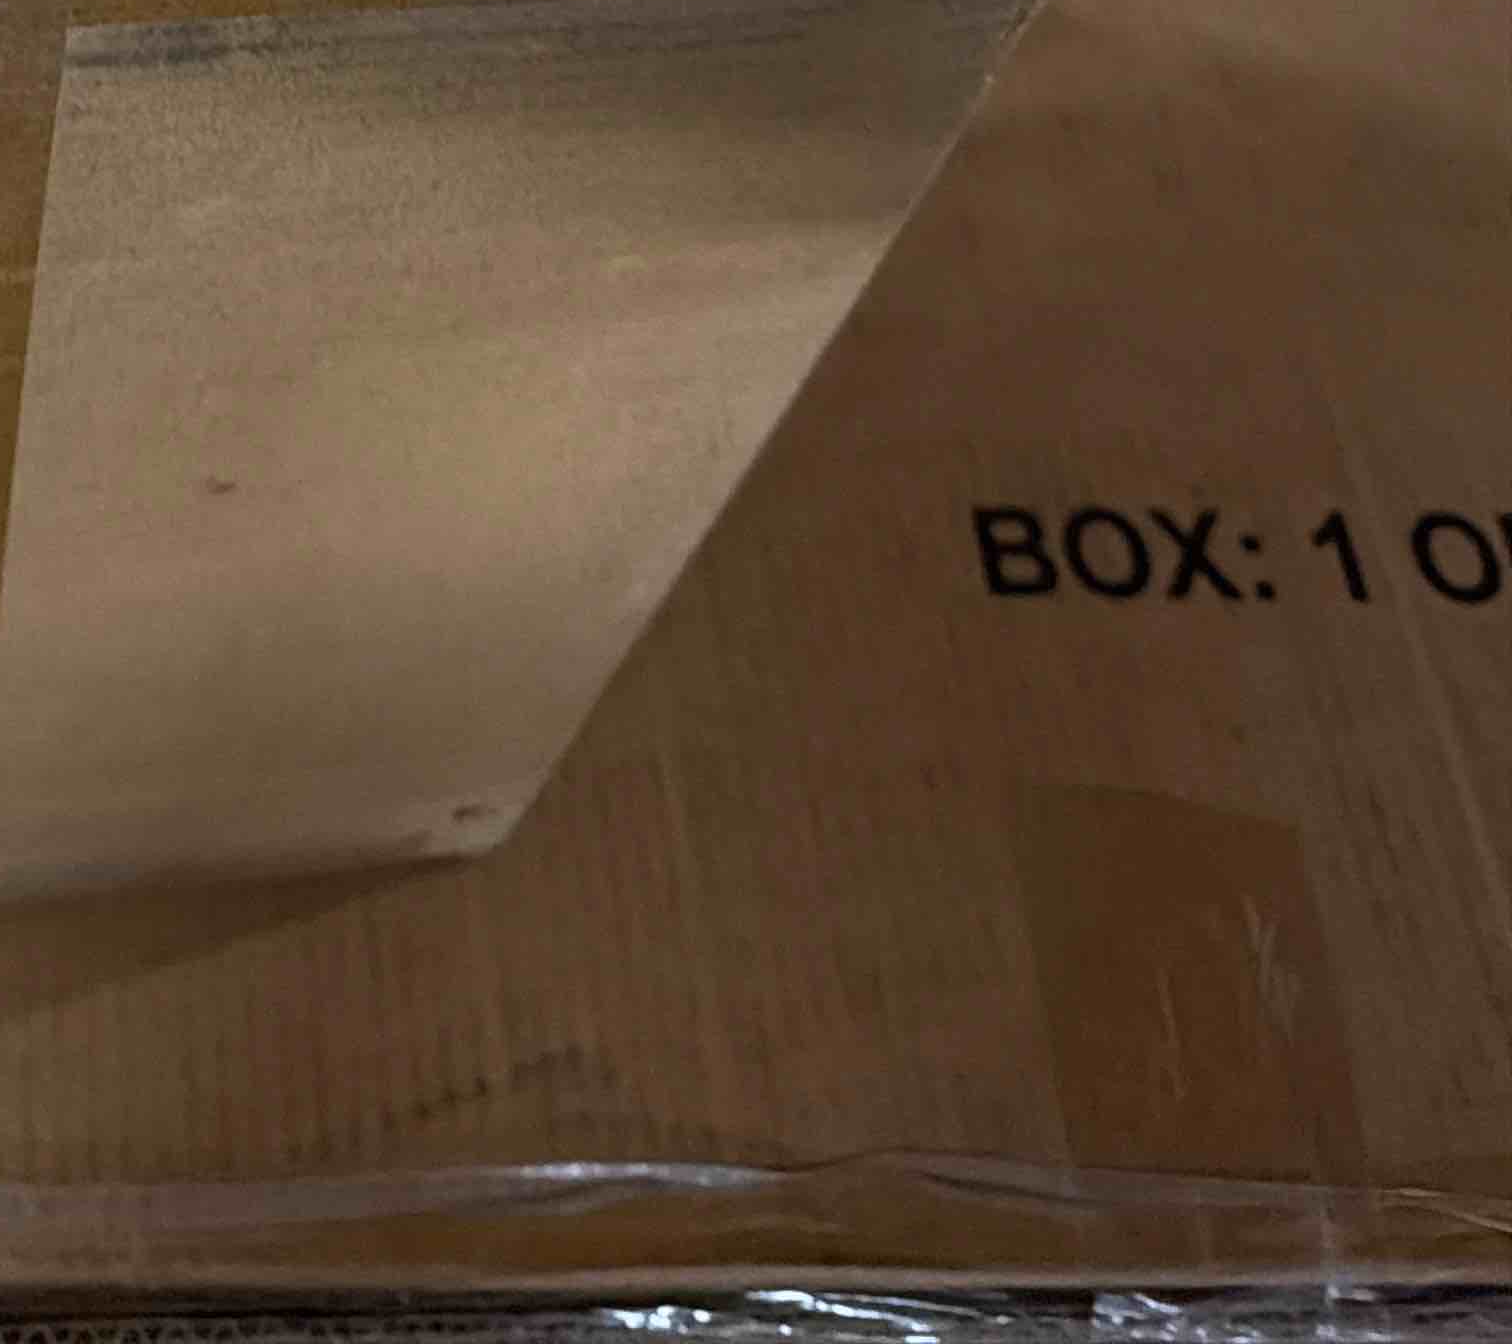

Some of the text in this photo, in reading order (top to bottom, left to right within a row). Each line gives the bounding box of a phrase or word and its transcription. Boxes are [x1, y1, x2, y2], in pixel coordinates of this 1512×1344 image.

[973, 504, 1512, 605] BOX: 1 O
